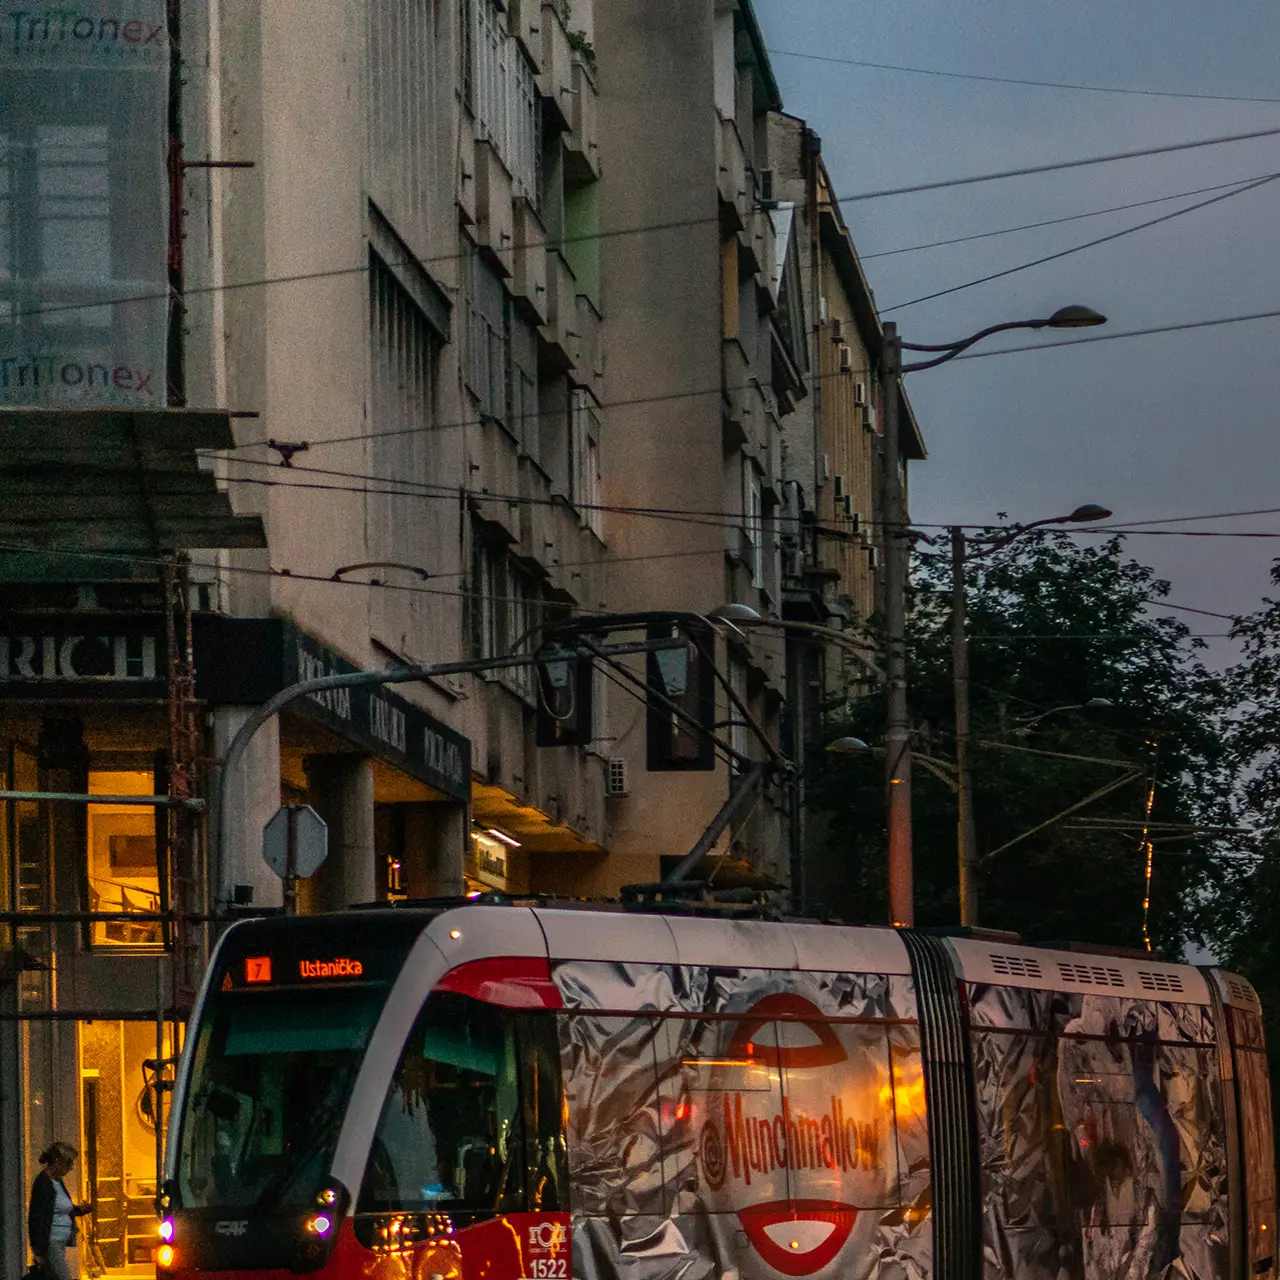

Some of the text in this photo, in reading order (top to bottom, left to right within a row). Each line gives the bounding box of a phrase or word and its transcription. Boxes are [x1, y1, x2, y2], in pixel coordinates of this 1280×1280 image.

[8, 11, 165, 44] TriTonex
[1, 356, 154, 396] TriTonex
[255, 963, 262, 979] 7
[300, 957, 363, 977] Ustanička
[723, 1092, 880, 1186] Munchmallow
[529, 1258, 568, 1279] 1522
